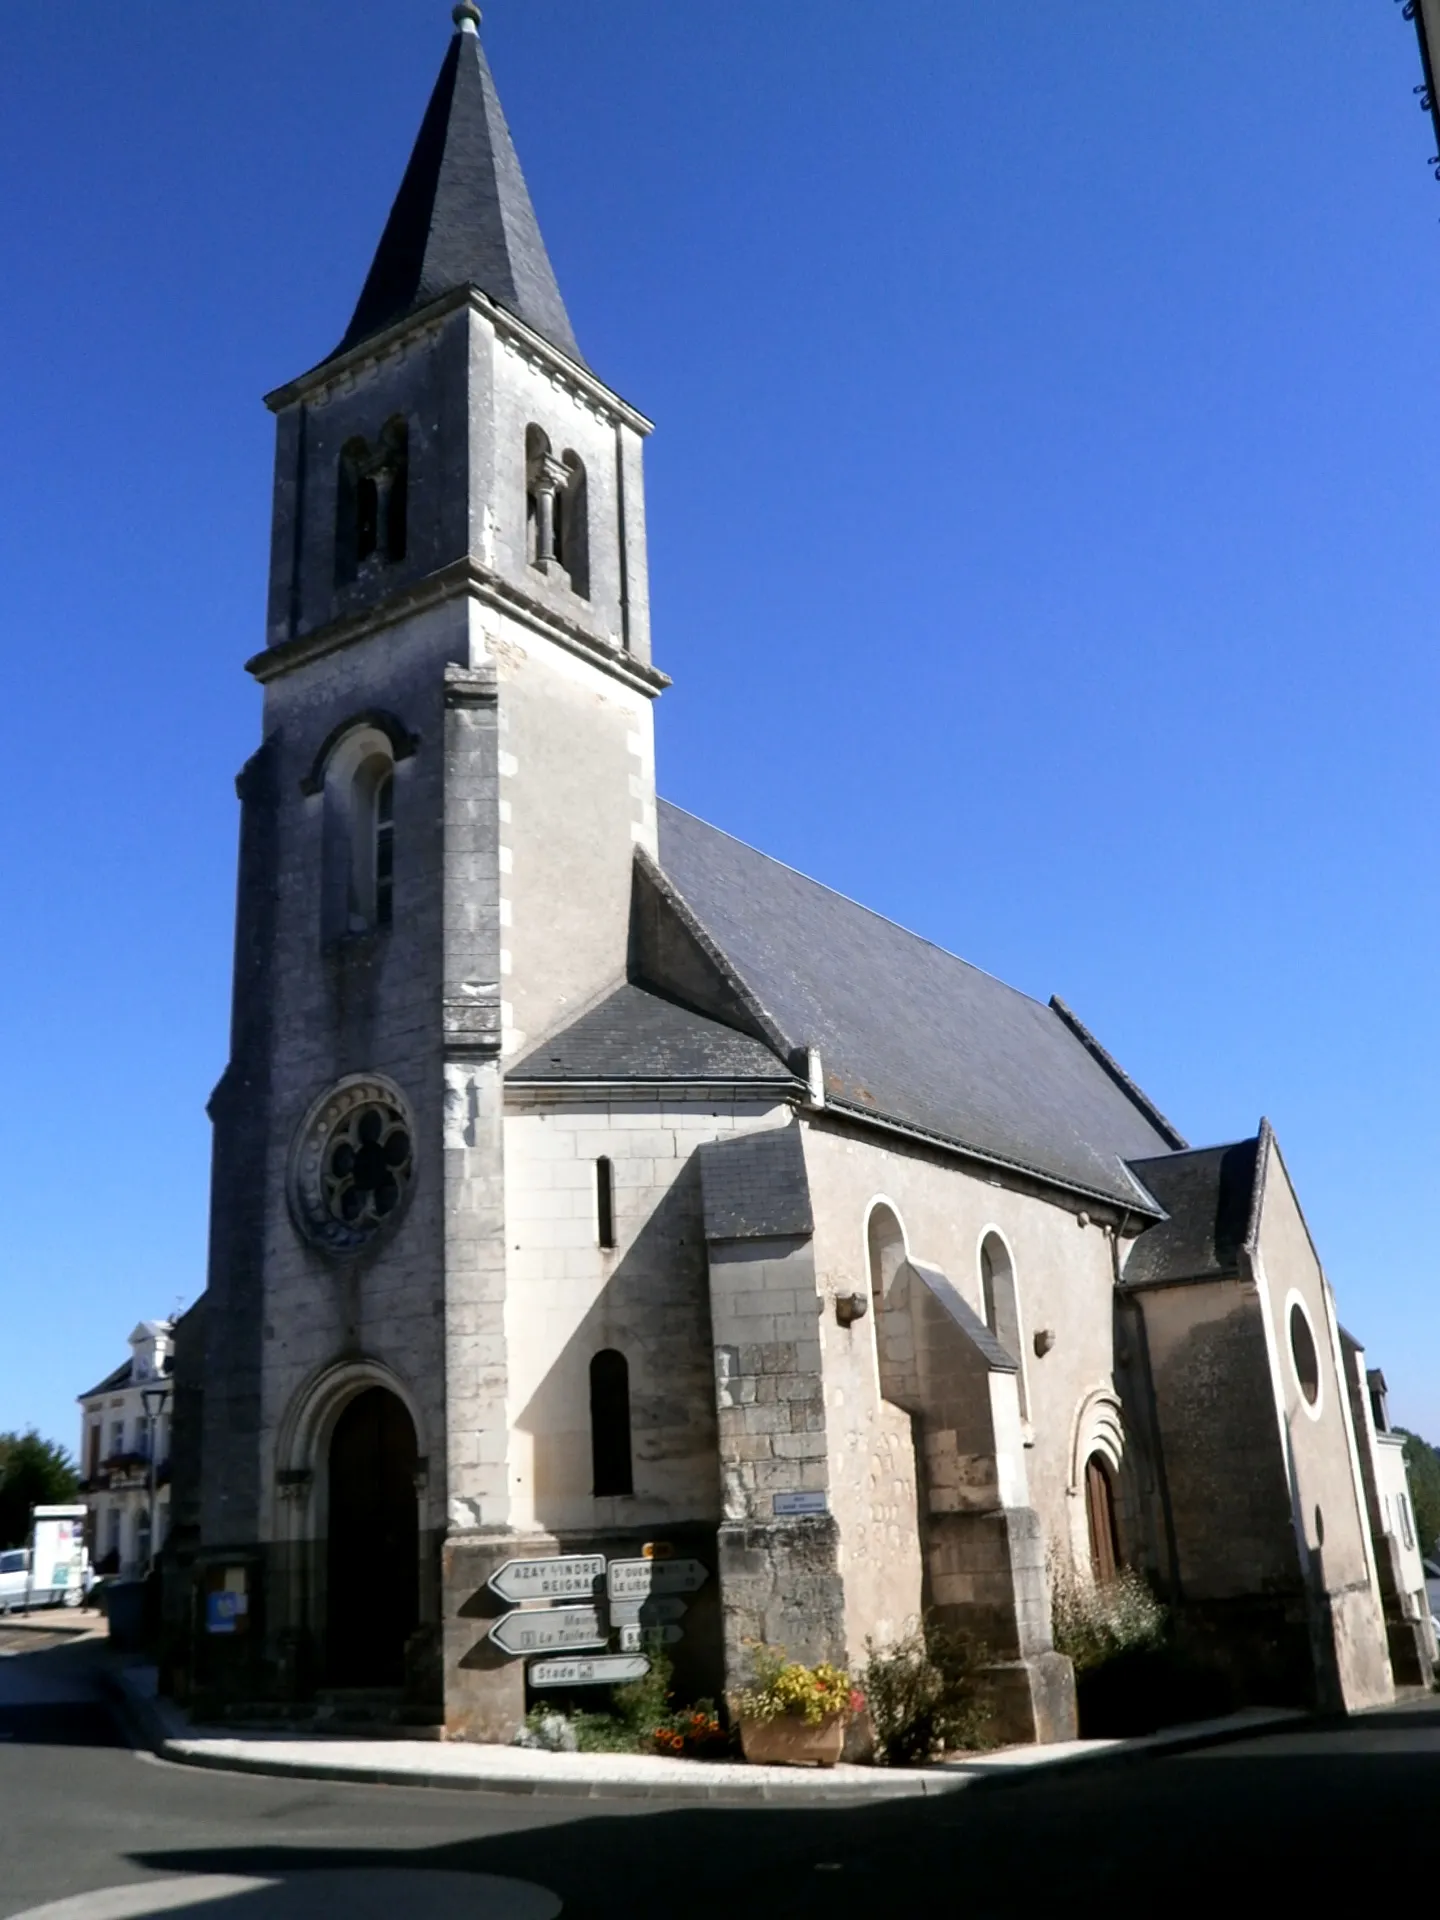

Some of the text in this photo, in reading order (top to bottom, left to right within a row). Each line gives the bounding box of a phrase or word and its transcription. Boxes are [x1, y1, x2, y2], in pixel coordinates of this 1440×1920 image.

[514, 1566, 546, 1579] AZAY
[542, 1578, 591, 1592] REIGNA
[614, 1579, 650, 1592] LE LIÈG
[557, 1627, 596, 1642] Tuileri
[538, 1666, 576, 1680] Stade
